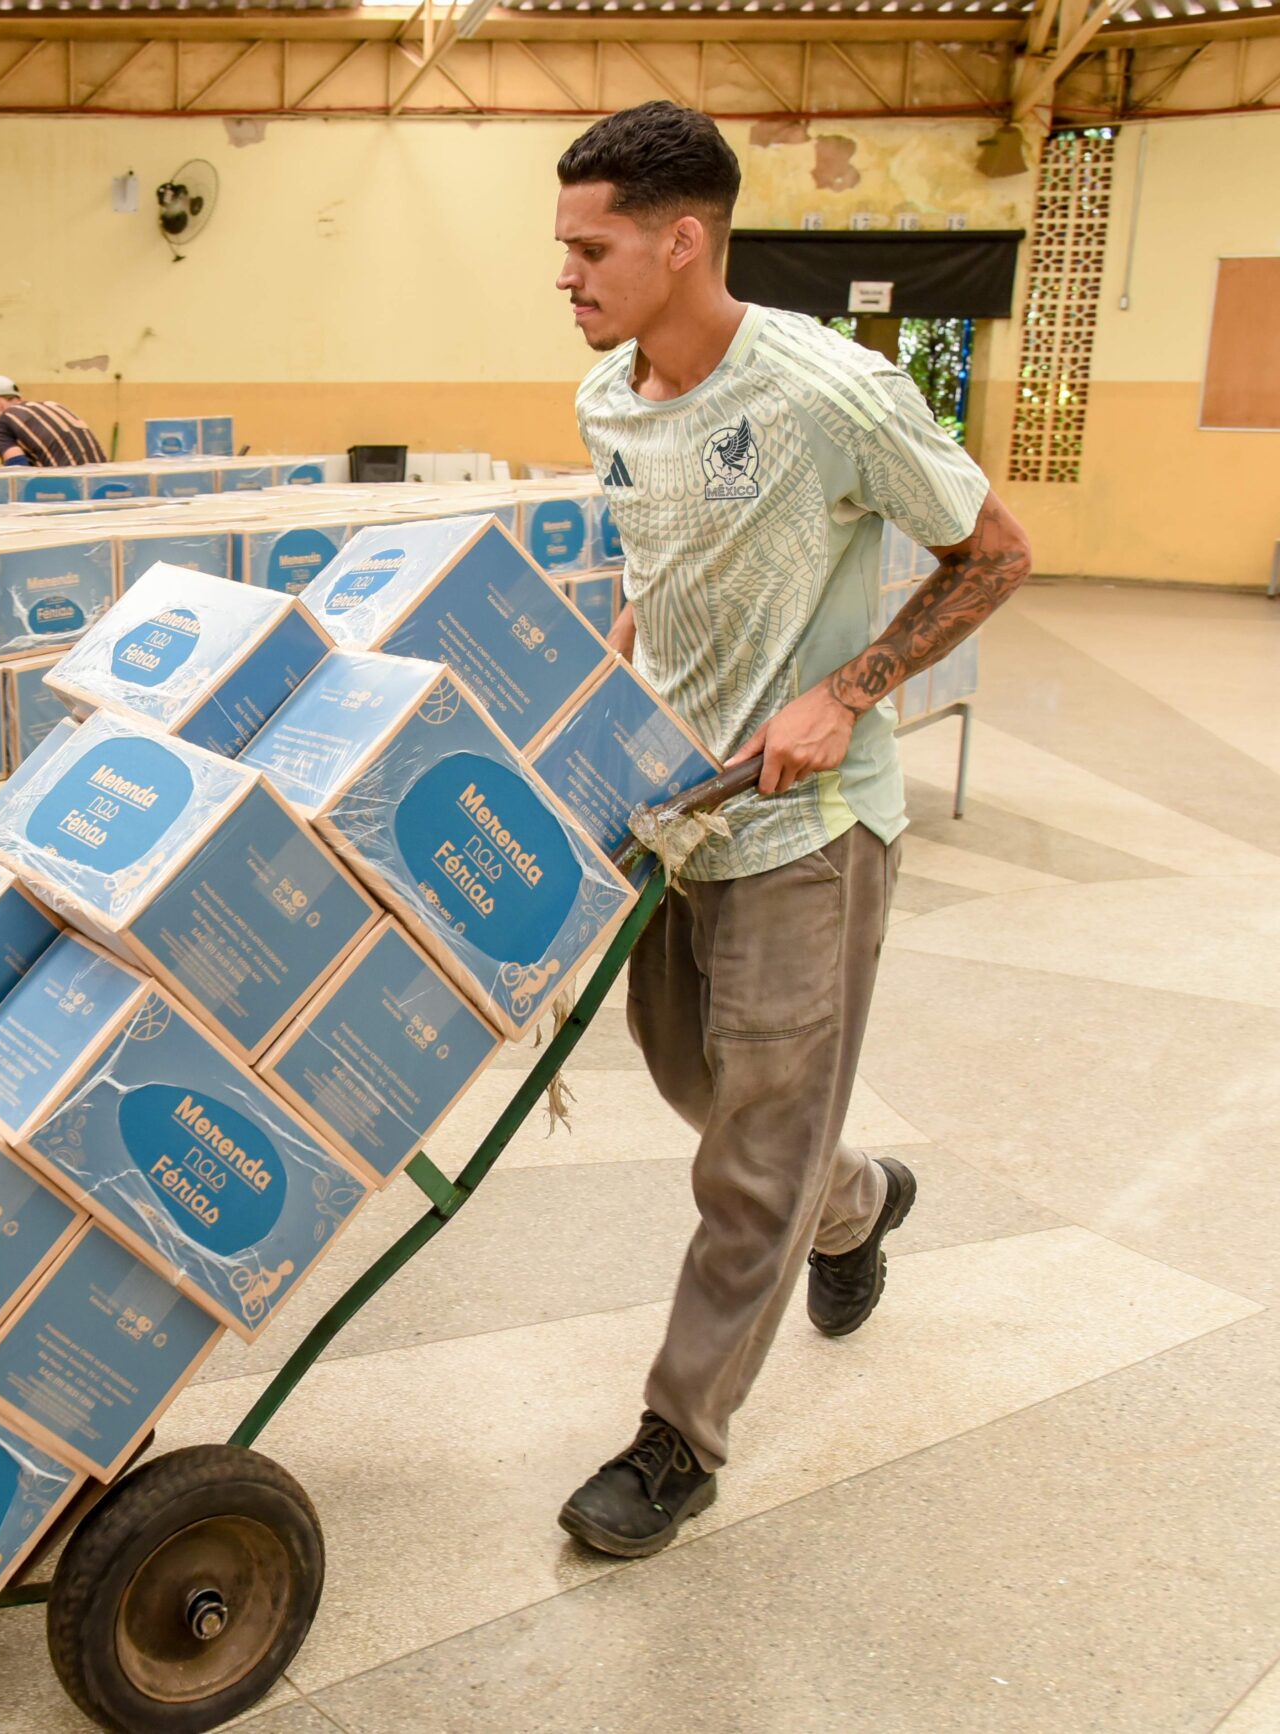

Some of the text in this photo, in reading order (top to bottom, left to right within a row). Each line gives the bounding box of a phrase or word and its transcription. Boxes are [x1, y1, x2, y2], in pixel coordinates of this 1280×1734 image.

[853, 218, 870, 230] 17
[900, 218, 918, 230] 18
[948, 218, 965, 230] 19
[707, 484, 755, 497] MÉXICO
[37, 605, 75, 620] Férias
[516, 614, 533, 631] Rio
[145, 630, 172, 647] nas
[509, 622, 537, 651] CLARO
[121, 643, 160, 669] Férias
[90, 765, 159, 807] Merenda
[89, 795, 121, 818] nas
[60, 810, 108, 845] Férias
[458, 783, 543, 887] Merenda
[465, 834, 502, 881] nas
[434, 841, 495, 916] Férias
[269, 886, 299, 916] CLARO
[403, 1024, 430, 1050] CLARO
[174, 1096, 272, 1190] Merenda
[184, 1145, 229, 1190] nas
[150, 1155, 220, 1225] Férias
